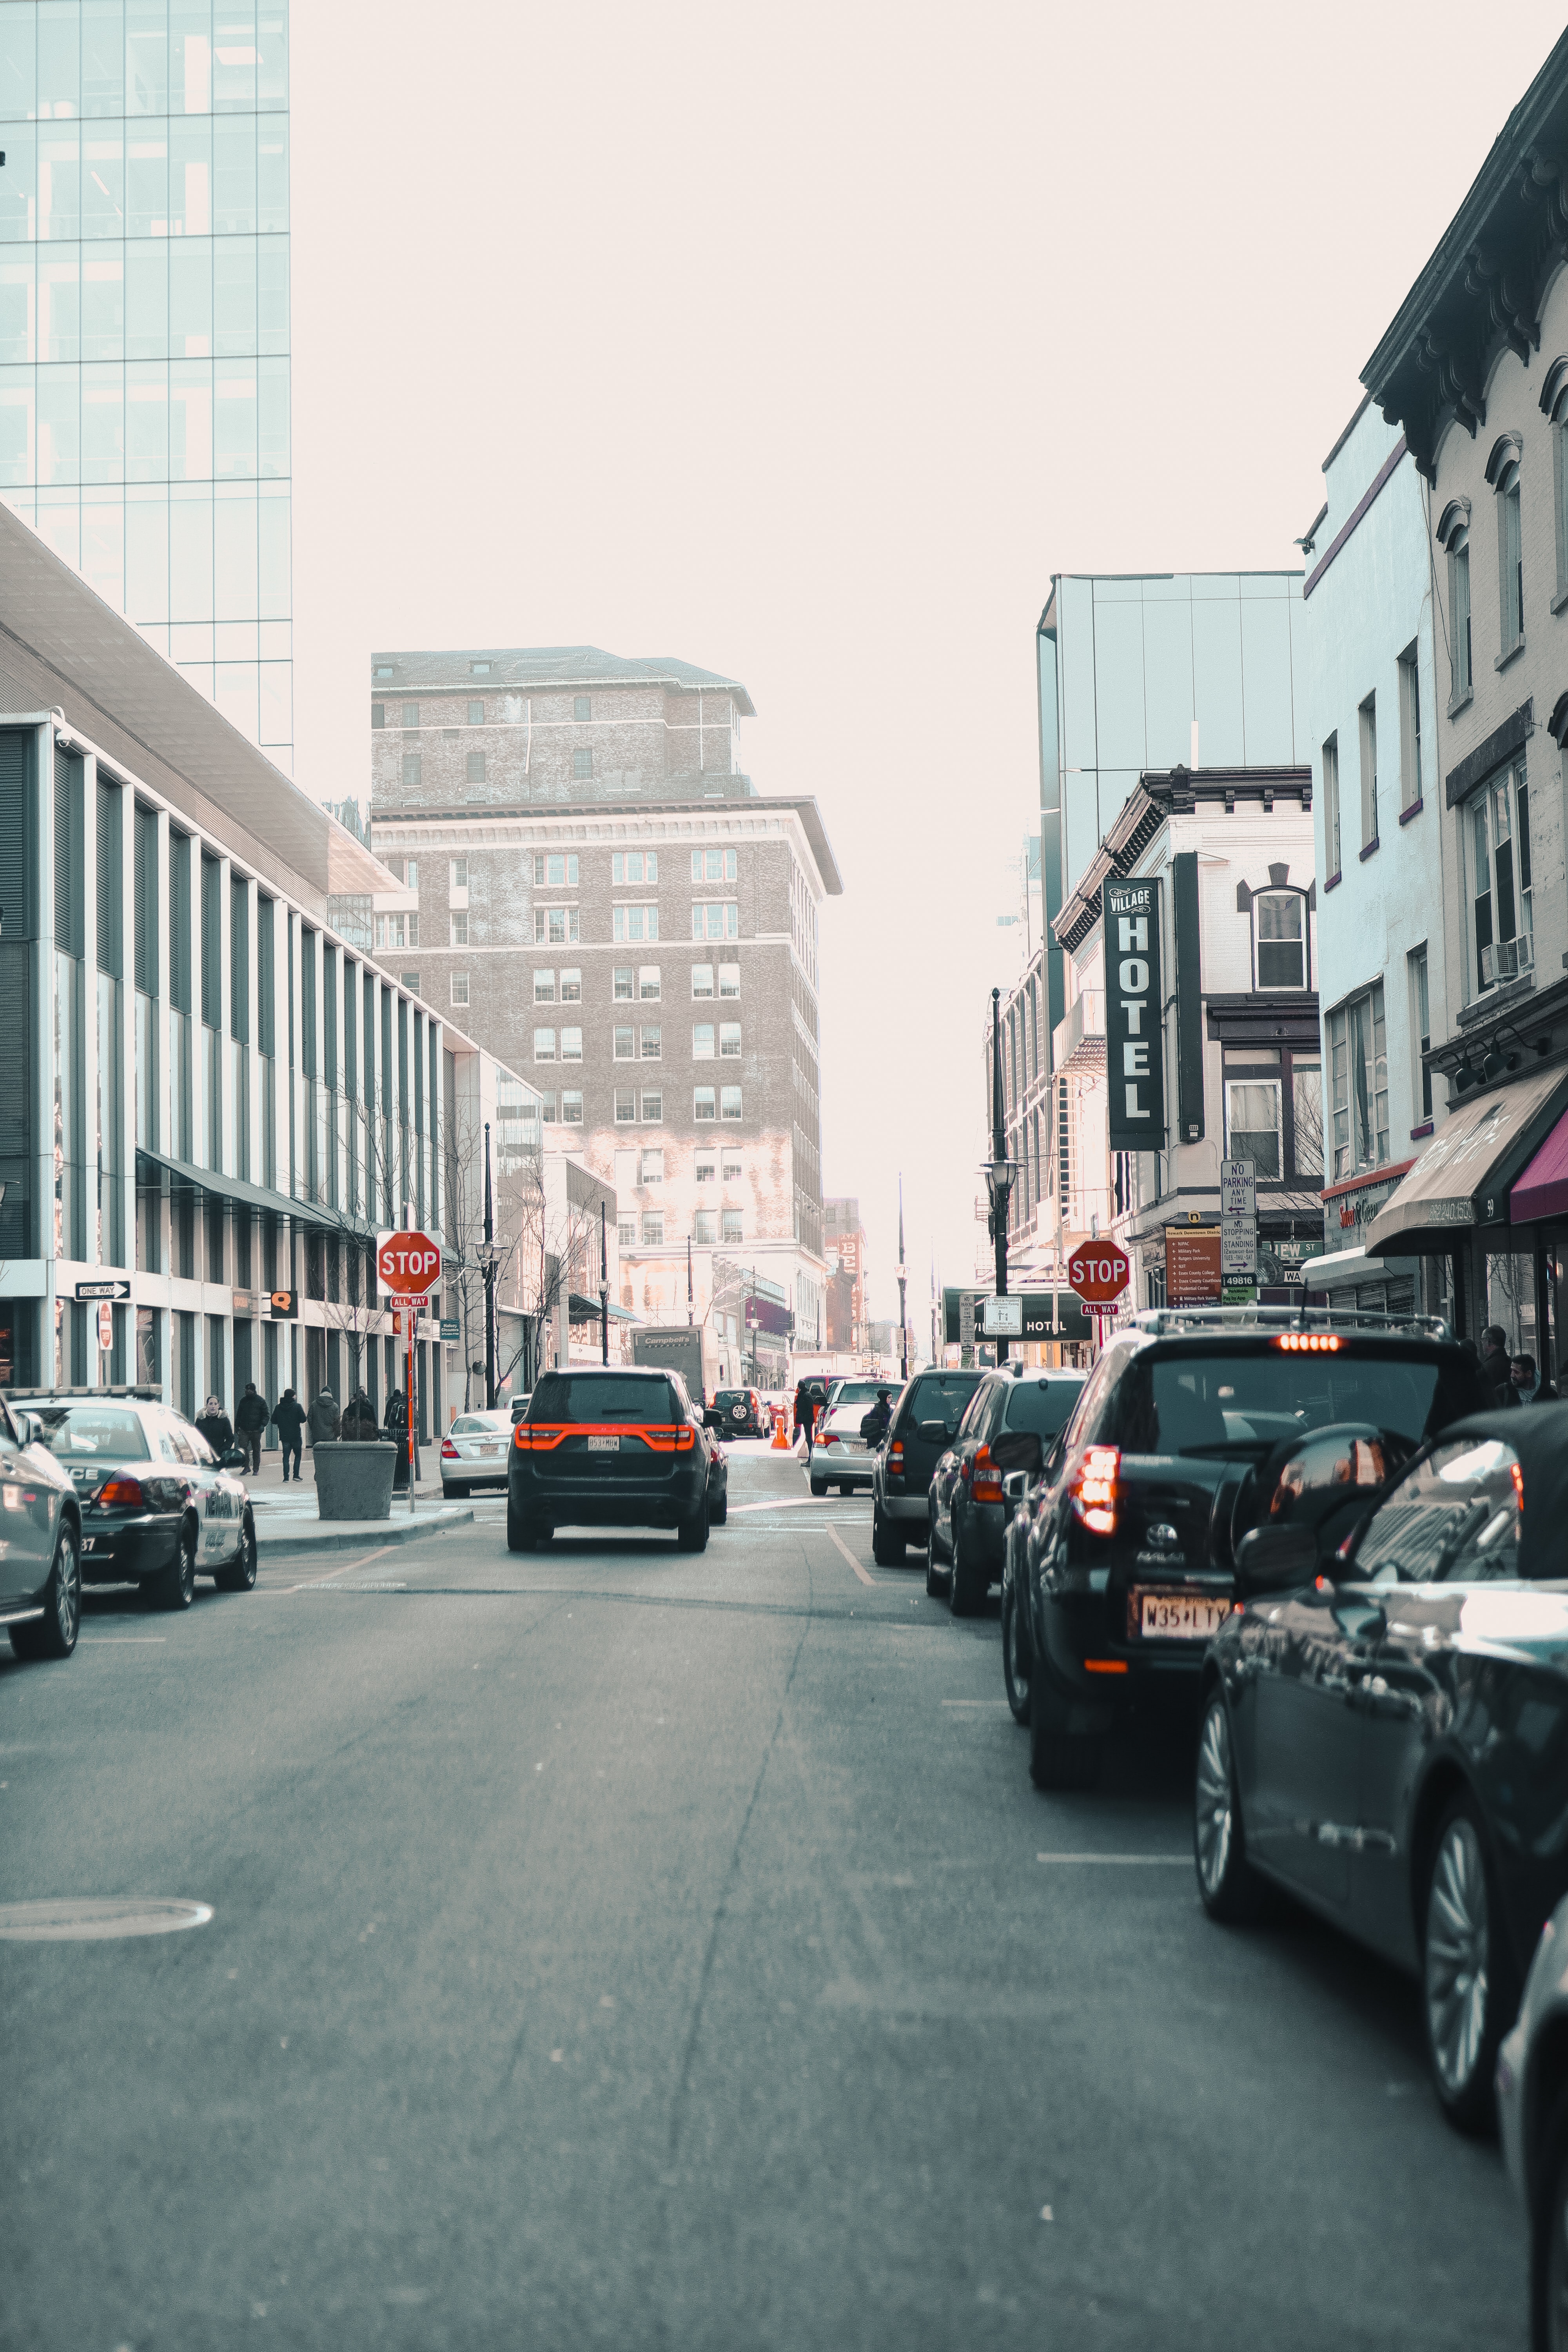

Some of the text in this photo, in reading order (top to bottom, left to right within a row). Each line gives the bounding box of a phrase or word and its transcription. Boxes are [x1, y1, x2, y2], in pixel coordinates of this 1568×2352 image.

[1110, 890, 1150, 912] VILLAGE
[1118, 917, 1150, 1118] HOTEL
[1231, 1164, 1244, 1175] NO
[1223, 1176, 1253, 1188] PARKING
[1339, 1205, 1355, 1229] Sweet
[1487, 1199, 1494, 1217] 59
[382, 1251, 437, 1275] STOP
[1072, 1259, 1126, 1283] STOP
[1227, 1276, 1252, 1285] 49816
[1286, 1272, 1301, 1281] WA
[271, 1292, 291, 1311] Q
[645, 1336, 690, 1345] Campbell's
